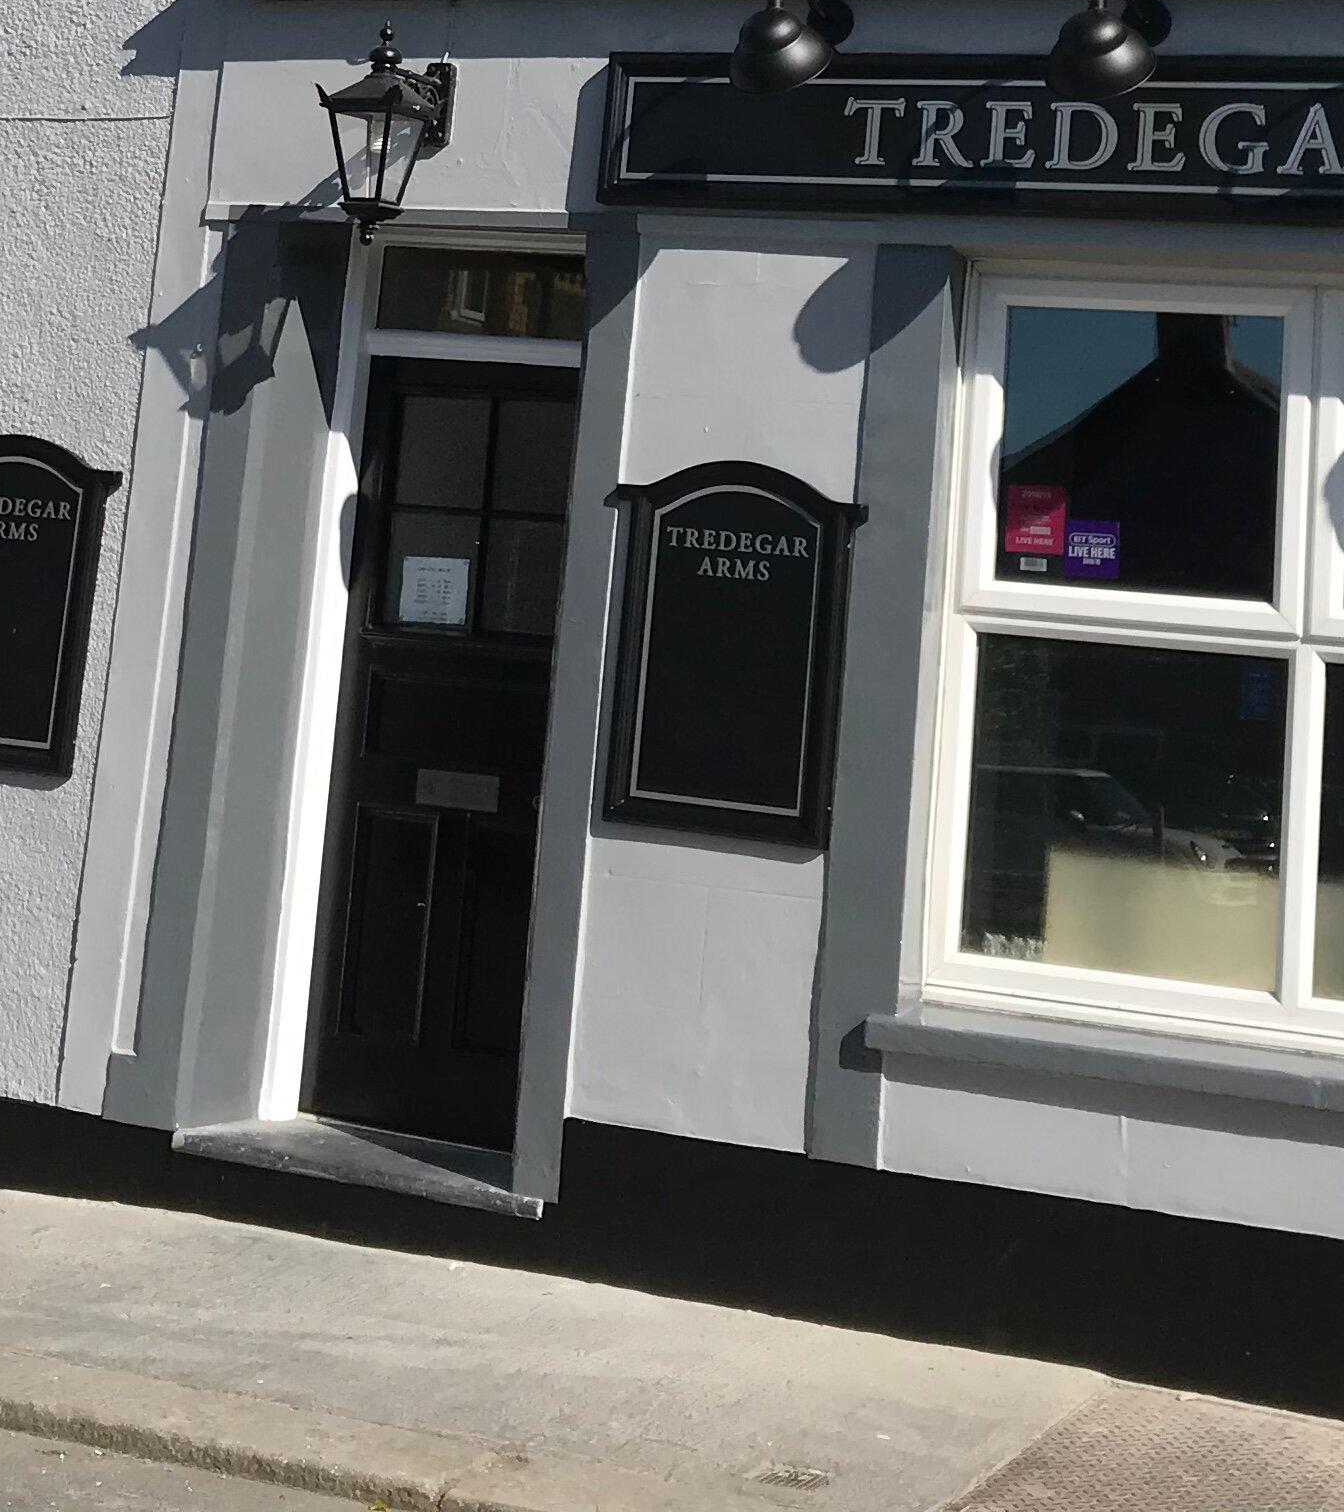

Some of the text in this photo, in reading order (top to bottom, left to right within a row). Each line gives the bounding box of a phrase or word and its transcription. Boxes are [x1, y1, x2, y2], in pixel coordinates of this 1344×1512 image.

[666, 526, 809, 558] TREDEGAR
[1088, 535, 1112, 545] Sport
[1068, 546, 1116, 560] LIVE HERE
[697, 556, 770, 581] ARMS
